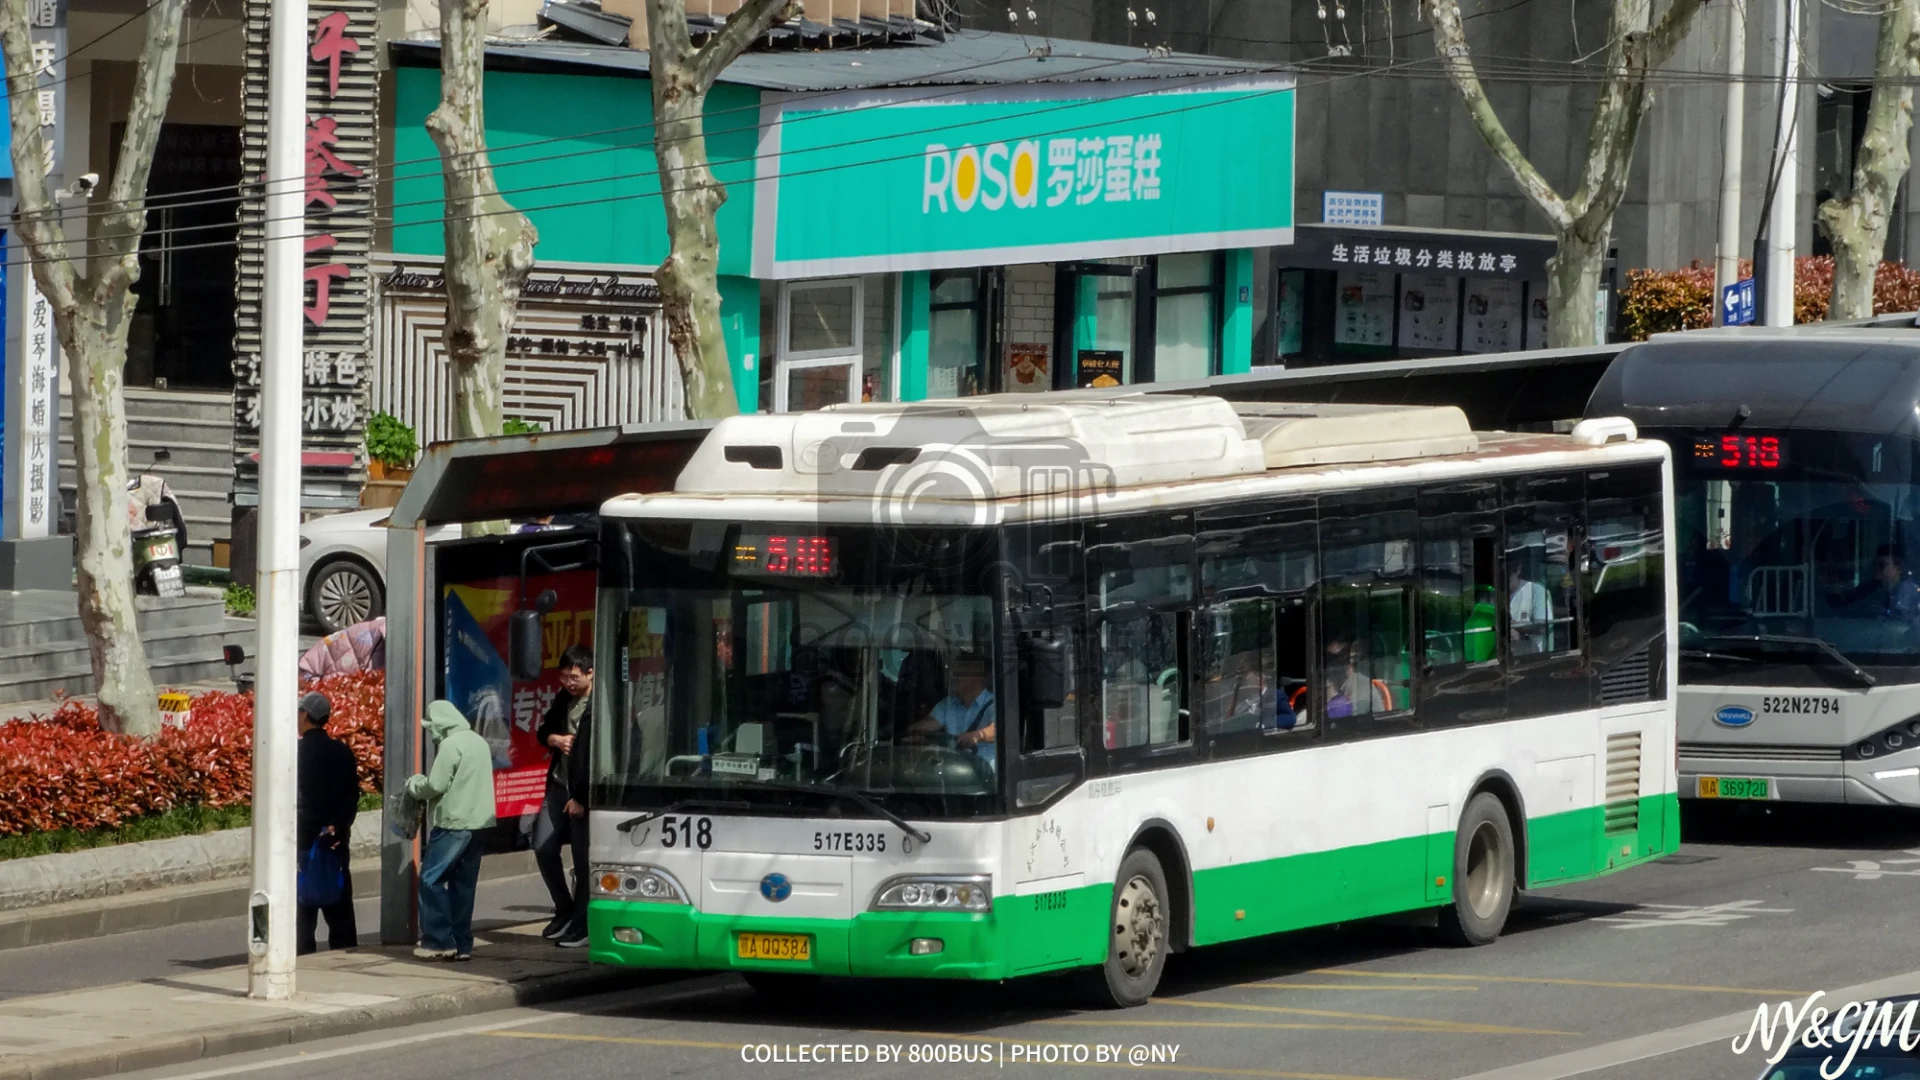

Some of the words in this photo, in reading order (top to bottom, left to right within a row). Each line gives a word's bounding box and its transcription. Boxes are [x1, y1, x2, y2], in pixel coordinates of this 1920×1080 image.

[1046, 133, 1163, 208] 罗莎蛋糕
[1331, 243, 1518, 273] 生活垃圾分类投放亭
[565, 277, 600, 297] and
[29, 280, 47, 525] 爱琴海婚庆摄影
[1763, 697, 1839, 714] 522N2794
[661, 816, 713, 849] 518
[814, 832, 886, 852] 517E335
